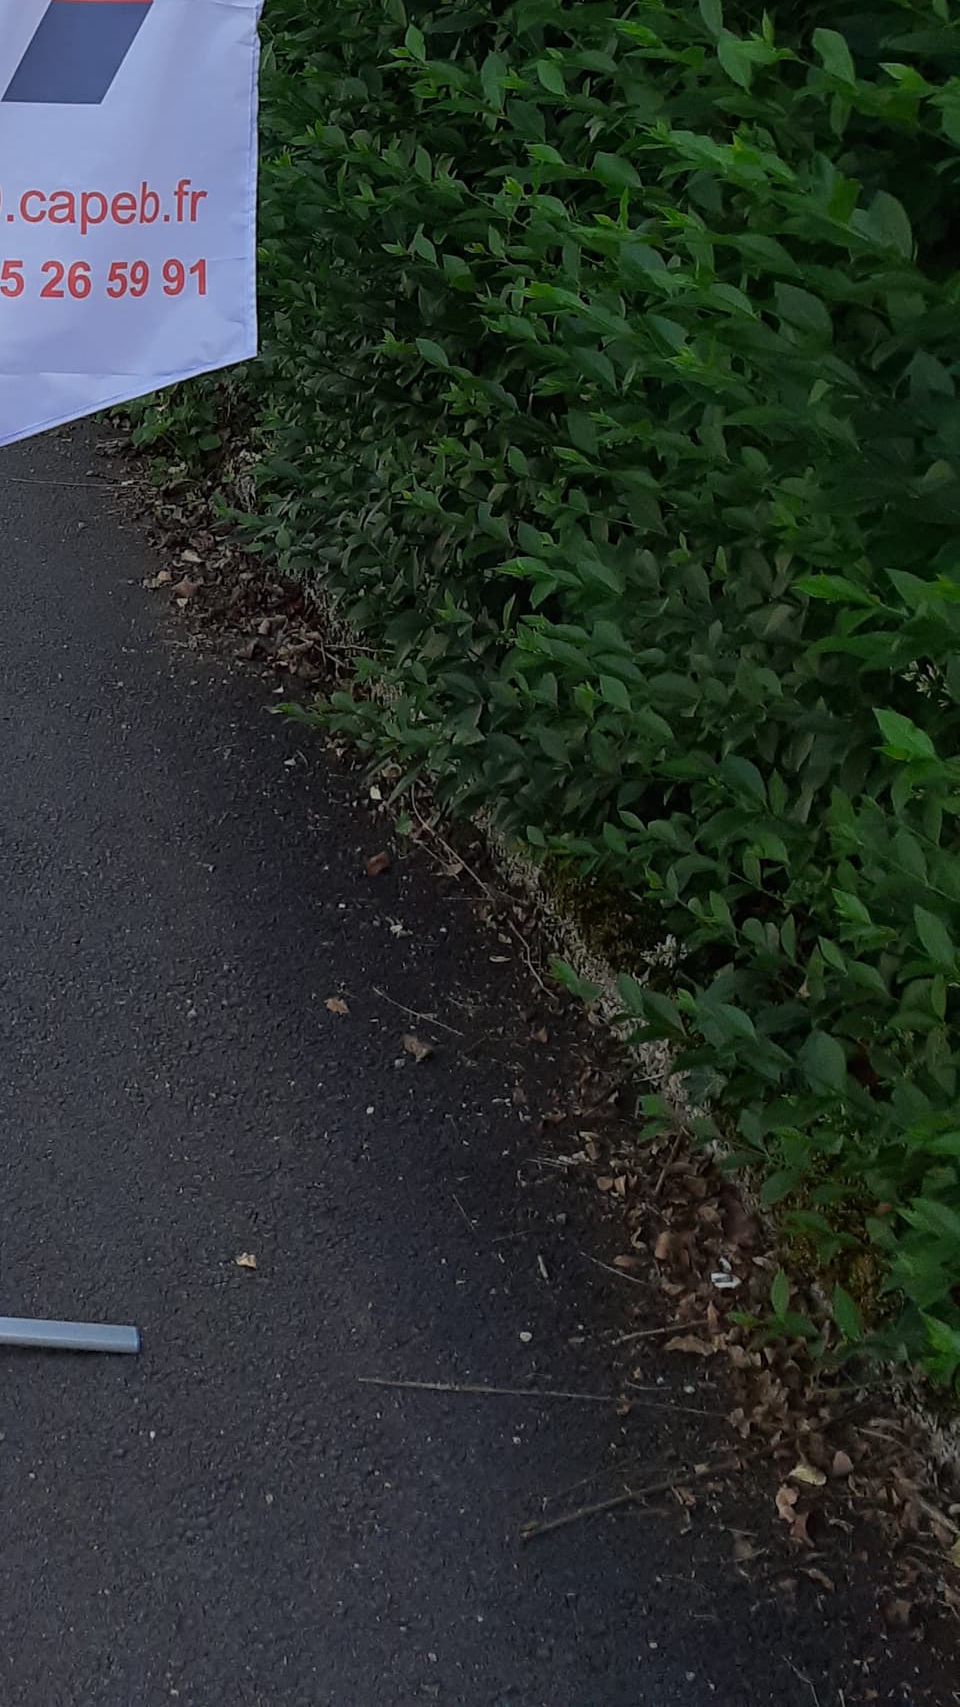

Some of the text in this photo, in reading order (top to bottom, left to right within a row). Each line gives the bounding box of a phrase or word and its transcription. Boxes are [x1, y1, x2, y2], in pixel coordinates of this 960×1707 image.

[39, 260, 92, 299] 26
[106, 260, 150, 299] 59
[162, 258, 208, 296] 91
